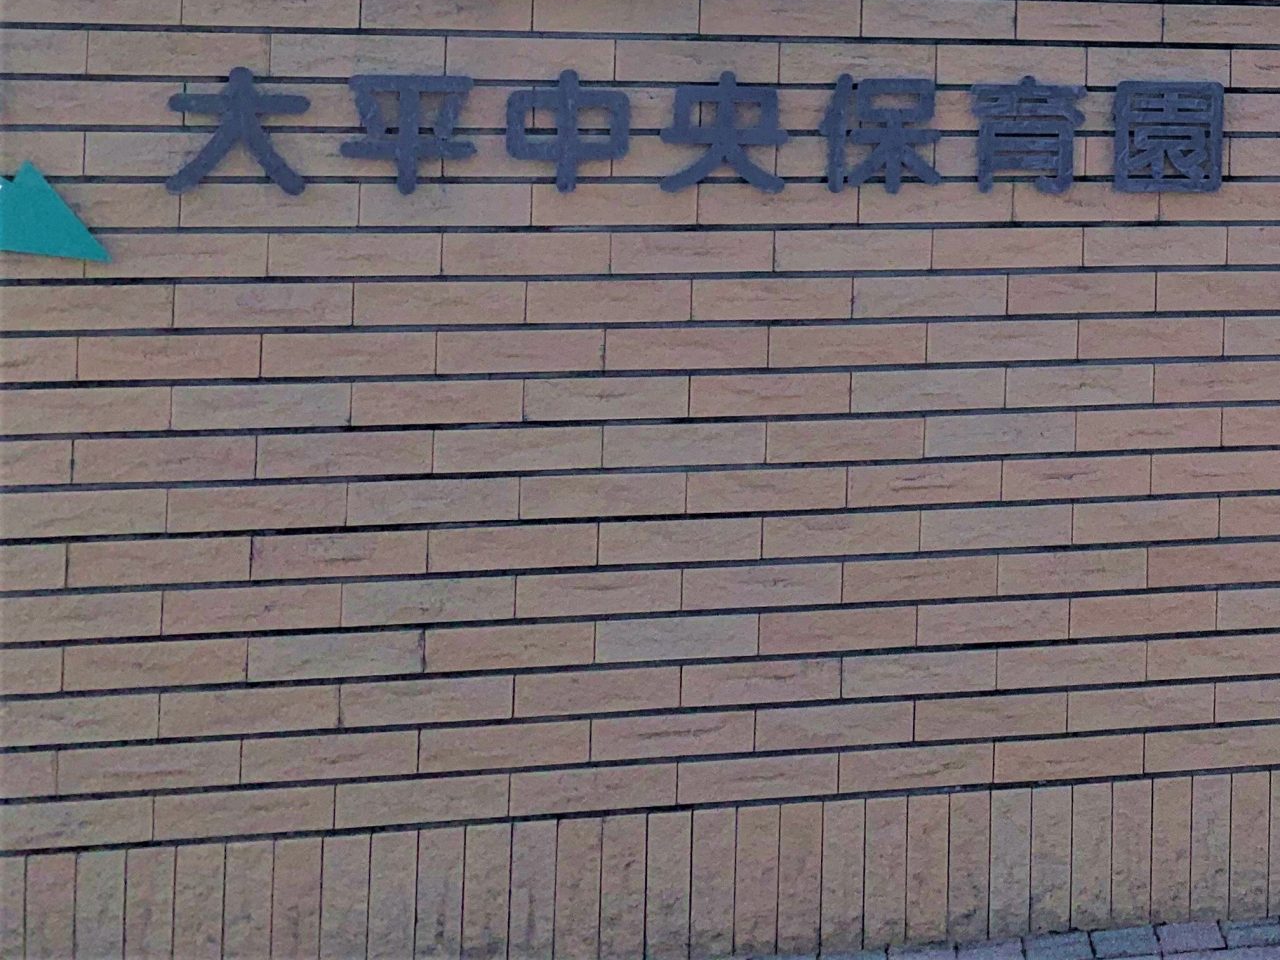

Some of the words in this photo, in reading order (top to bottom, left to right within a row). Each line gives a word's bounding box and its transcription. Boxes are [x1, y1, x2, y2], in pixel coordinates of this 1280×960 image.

[165, 66, 1224, 195] 大平中央保育園
